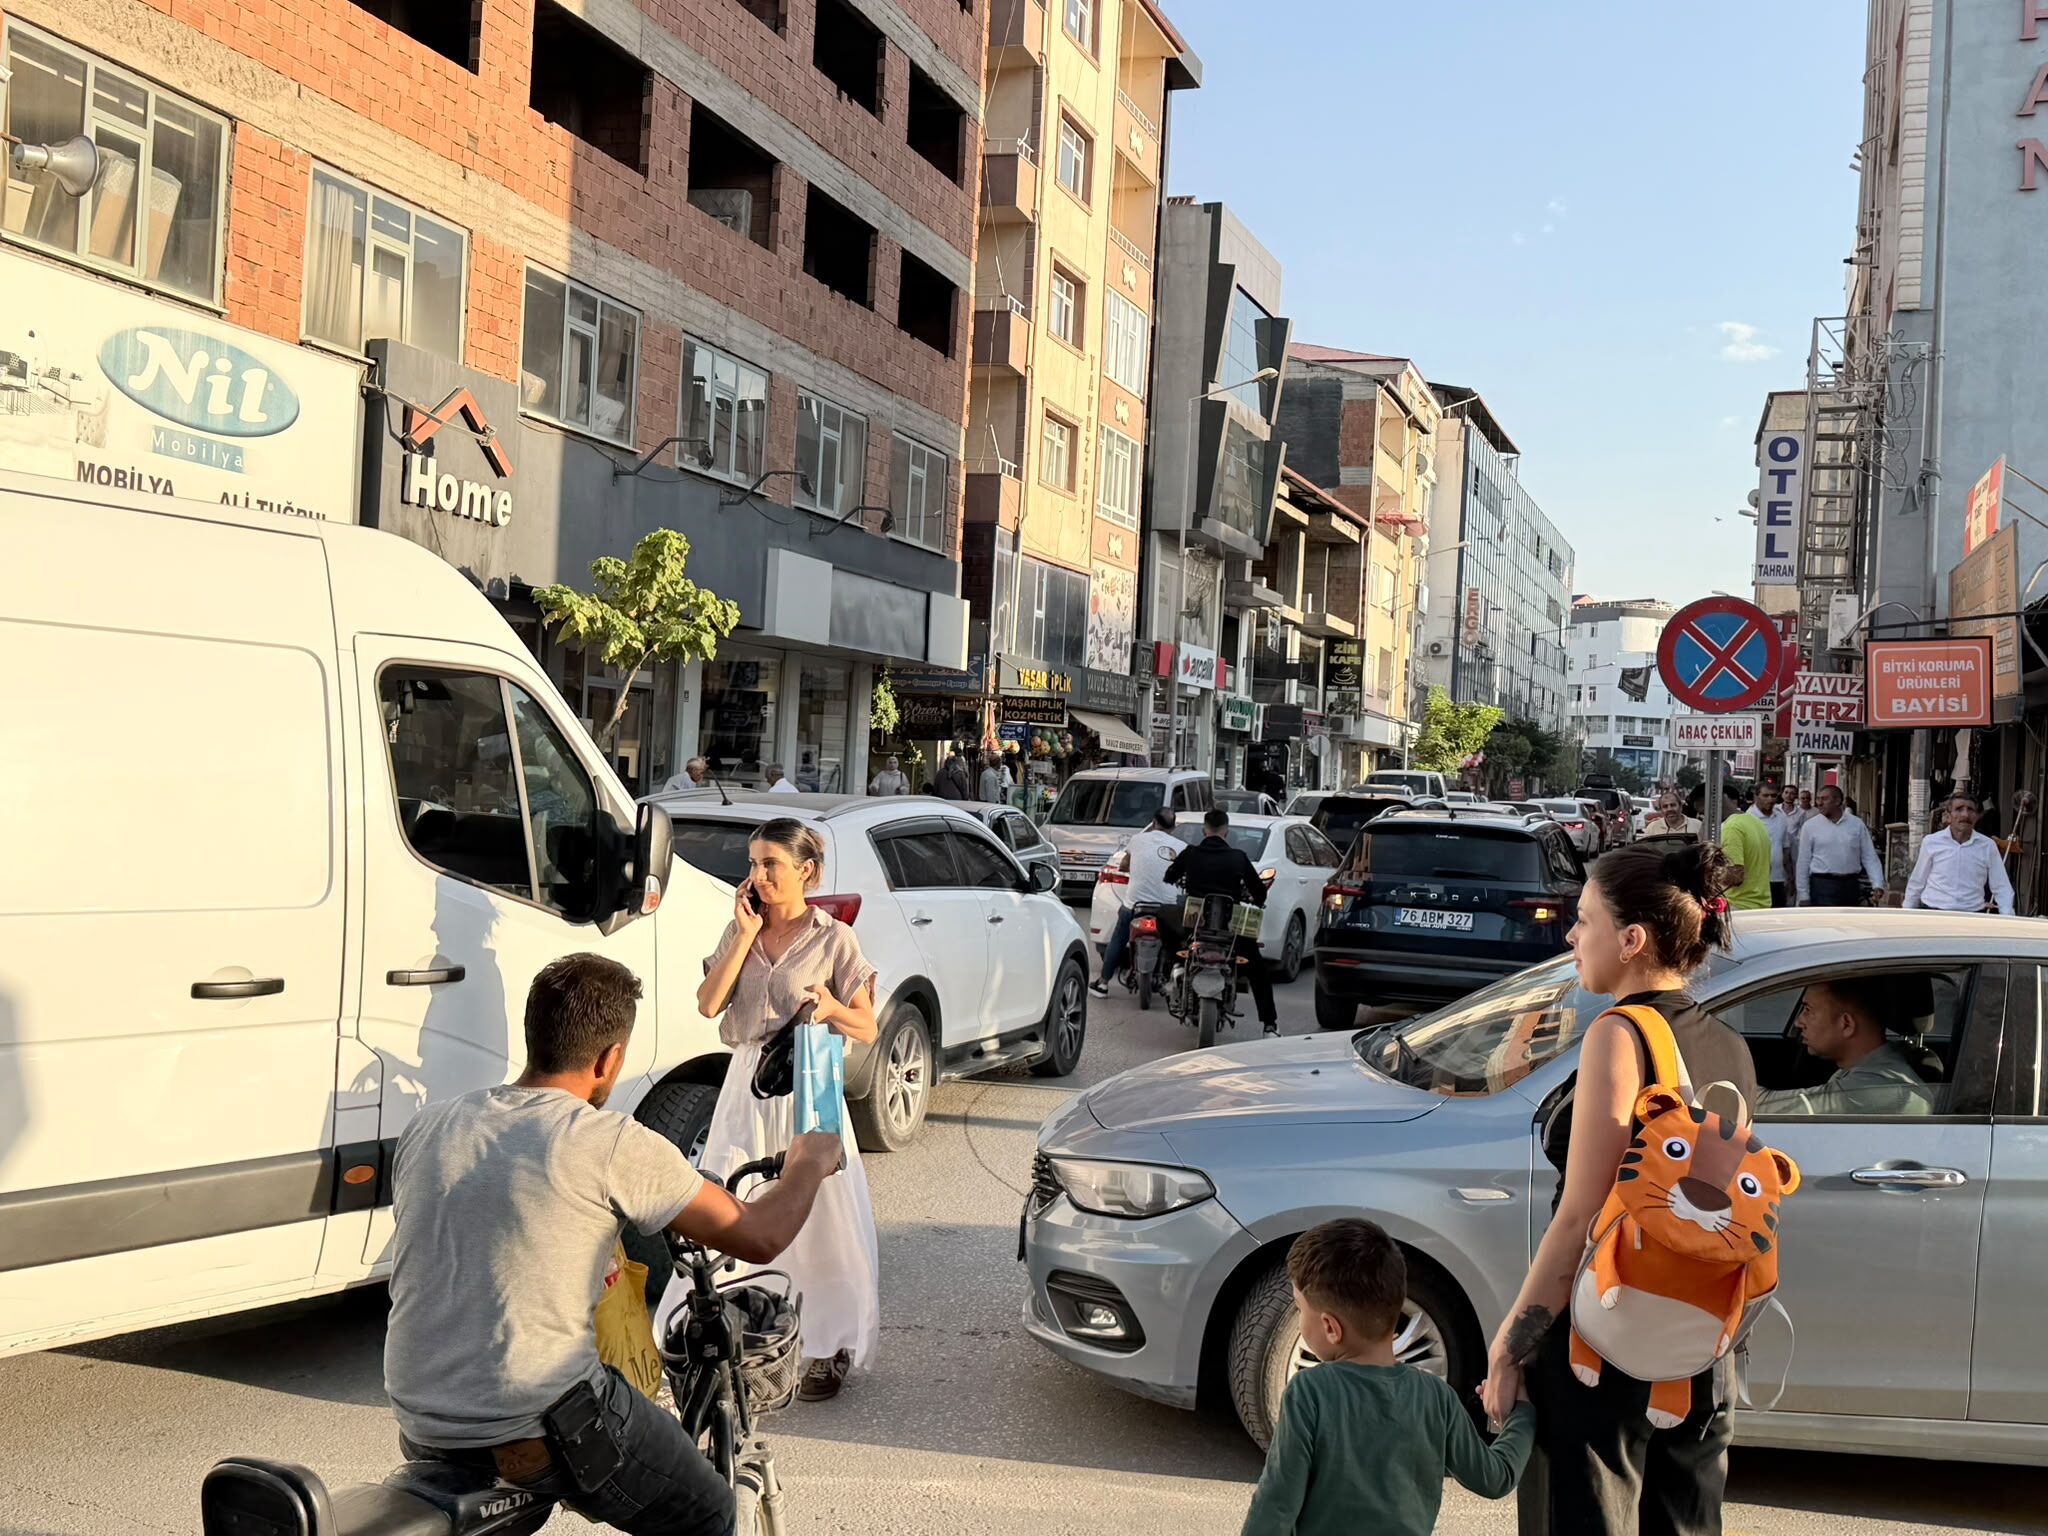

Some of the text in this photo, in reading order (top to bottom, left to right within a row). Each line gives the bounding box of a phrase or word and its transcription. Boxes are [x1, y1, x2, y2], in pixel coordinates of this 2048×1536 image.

[127, 330, 268, 423] Nil
[152, 431, 244, 468] Mobilya
[77, 460, 175, 497] MOBİLYA
[408, 452, 513, 527] Home
[1765, 436, 1799, 559] OTEL
[1758, 564, 1795, 577] TAHRAN
[1882, 658, 1975, 673] BİTKİ KORUMA
[1018, 667, 1073, 693] YAŞAR İPLİK
[1797, 675, 1864, 695] YAVUZ
[1896, 674, 1962, 690] ÜRÜNLERİ
[1005, 698, 1064, 710] YAŞAR İPLİK
[1796, 698, 1864, 722] TERZİ
[1892, 693, 1969, 713] BAYİSİ
[1004, 710, 1062, 722] KOZMETİK
[1678, 725, 1708, 744] ARAÇ
[1710, 720, 1753, 745] ÇEKİLİR
[1795, 732, 1850, 750] TAHRAN
[1402, 909, 1417, 921] 76
[1447, 913, 1471, 926] 327
